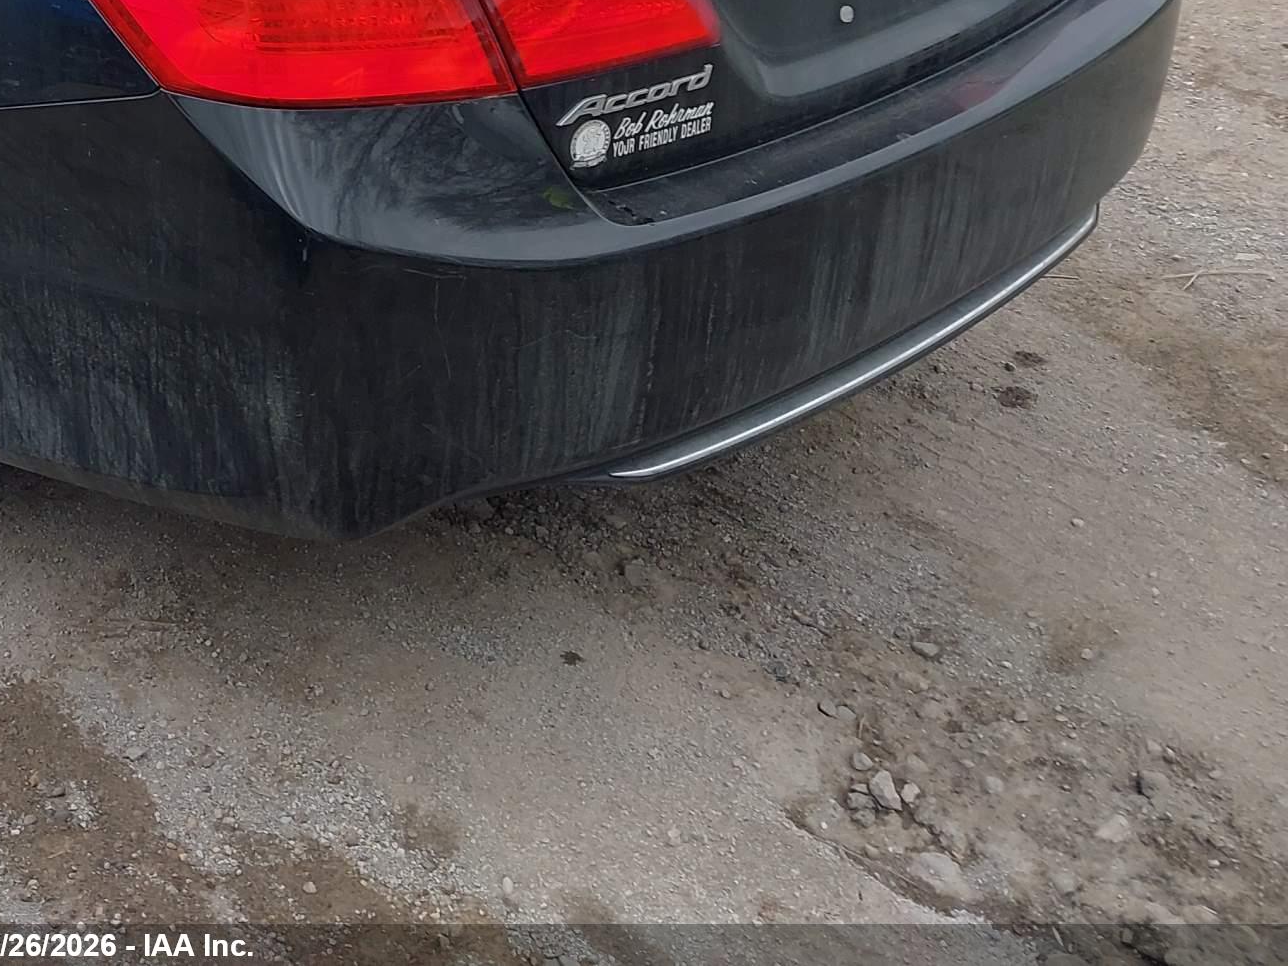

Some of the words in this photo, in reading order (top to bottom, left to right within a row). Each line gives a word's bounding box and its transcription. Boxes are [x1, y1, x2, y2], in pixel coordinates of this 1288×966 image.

[555, 63, 713, 127] Accord
[613, 112, 647, 140] Bob
[644, 101, 715, 133] Rohrman
[613, 138, 636, 158] YOUR
[638, 125, 679, 151] FRIENDLY
[681, 117, 712, 139] DEALER
